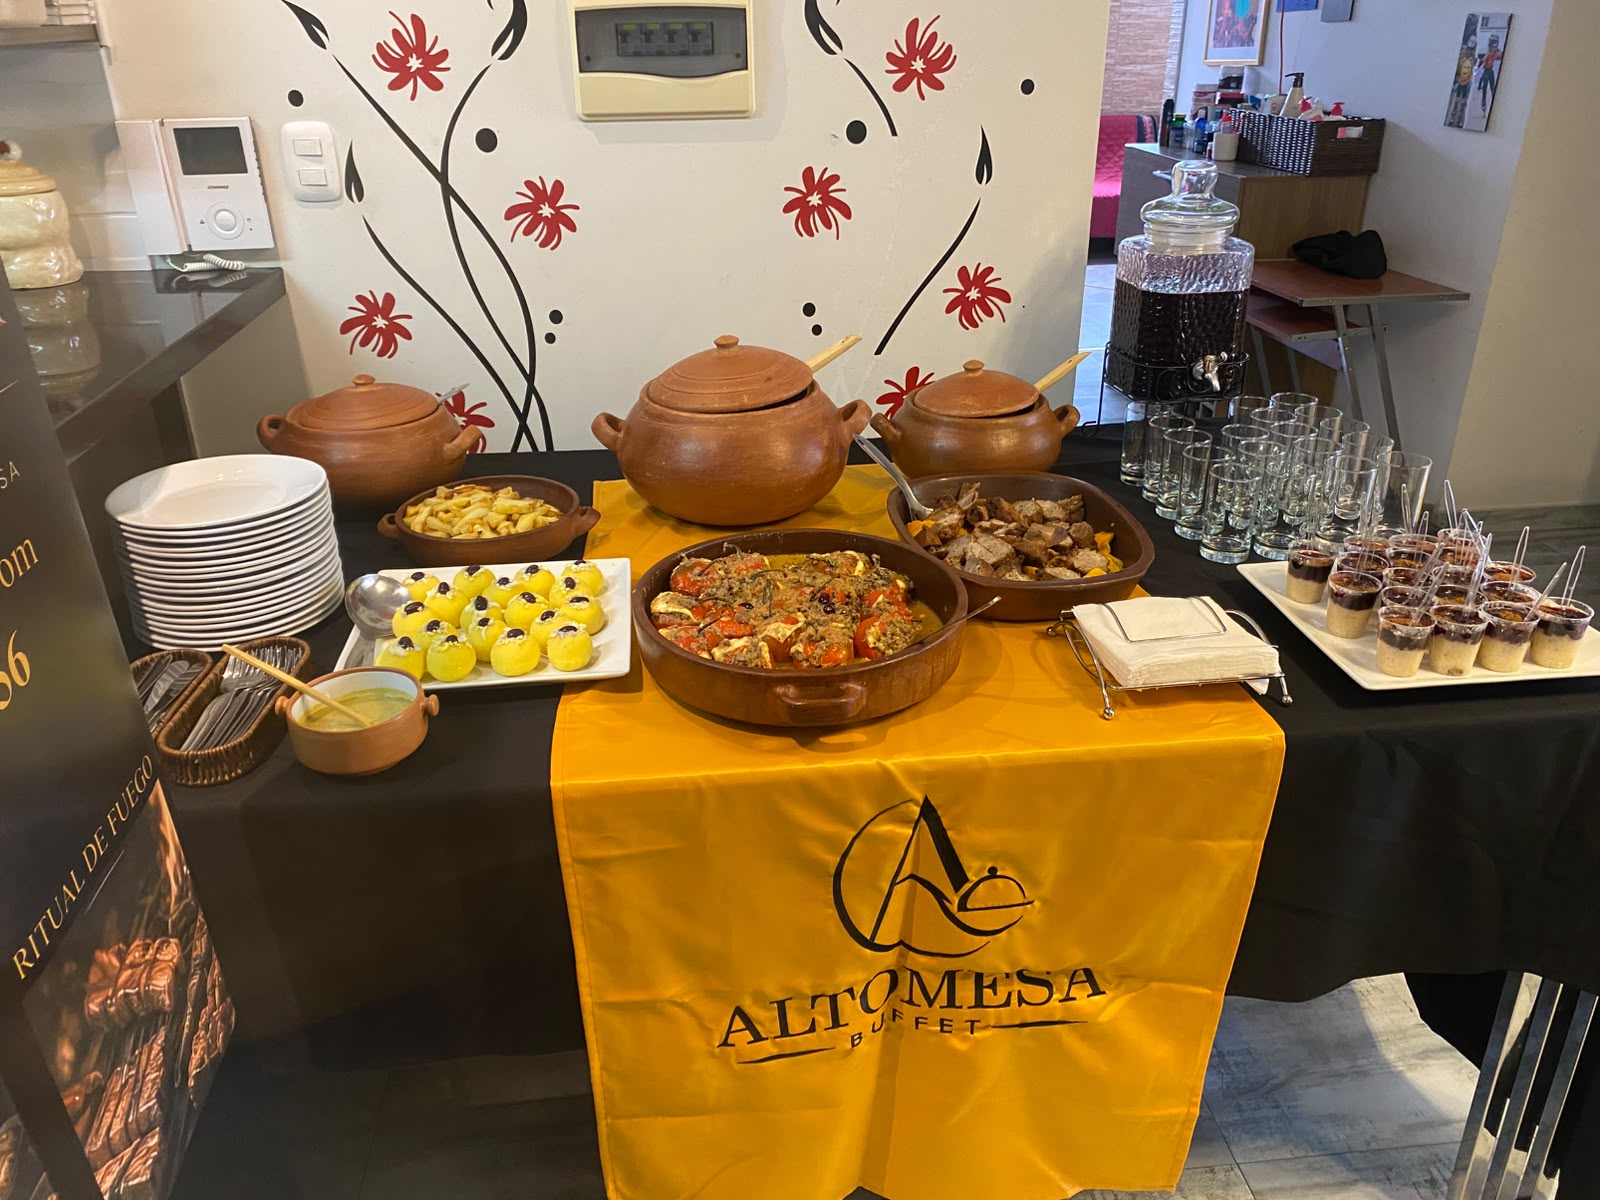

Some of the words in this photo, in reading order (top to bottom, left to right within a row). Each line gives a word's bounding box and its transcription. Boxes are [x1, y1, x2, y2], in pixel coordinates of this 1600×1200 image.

[12, 870, 86, 980] RITUAL
[82, 826, 109, 873] DE
[107, 755, 153, 836] FUEGO
[717, 966, 1107, 1048] ALTOMESA
[850, 1008, 981, 1049] BUFFET
